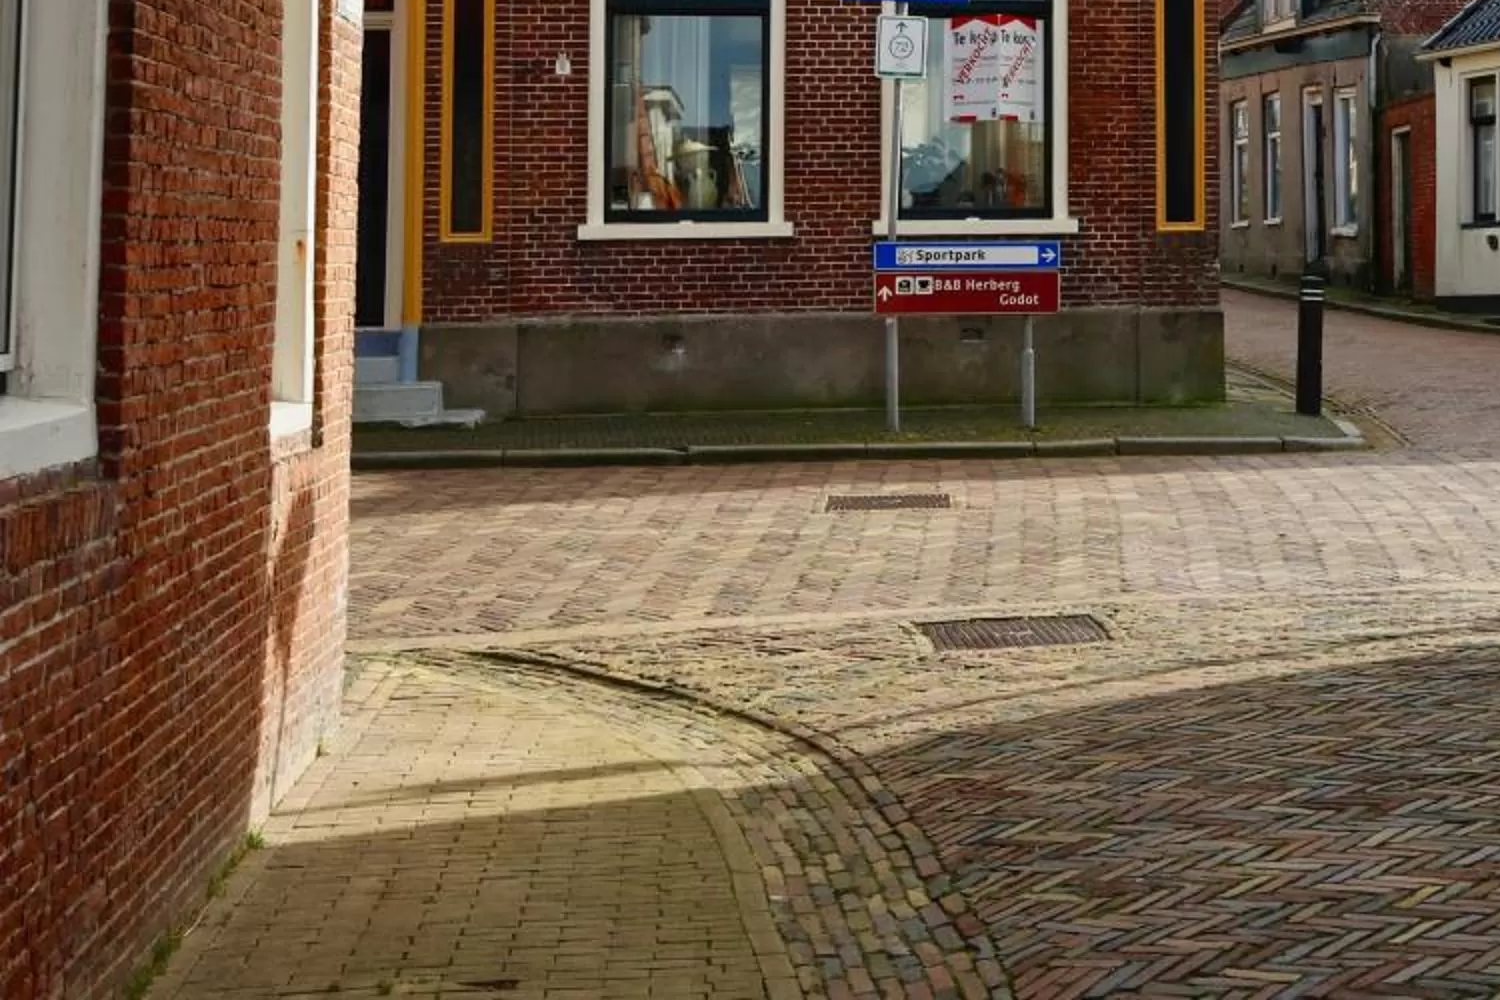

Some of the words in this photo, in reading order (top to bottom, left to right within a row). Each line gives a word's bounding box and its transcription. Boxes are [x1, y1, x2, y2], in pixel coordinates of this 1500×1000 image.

[916, 249, 986, 263] Sportpark
[935, 279, 961, 291] B&B
[965, 278, 1020, 293] Herberg
[999, 293, 1040, 305] Godot
